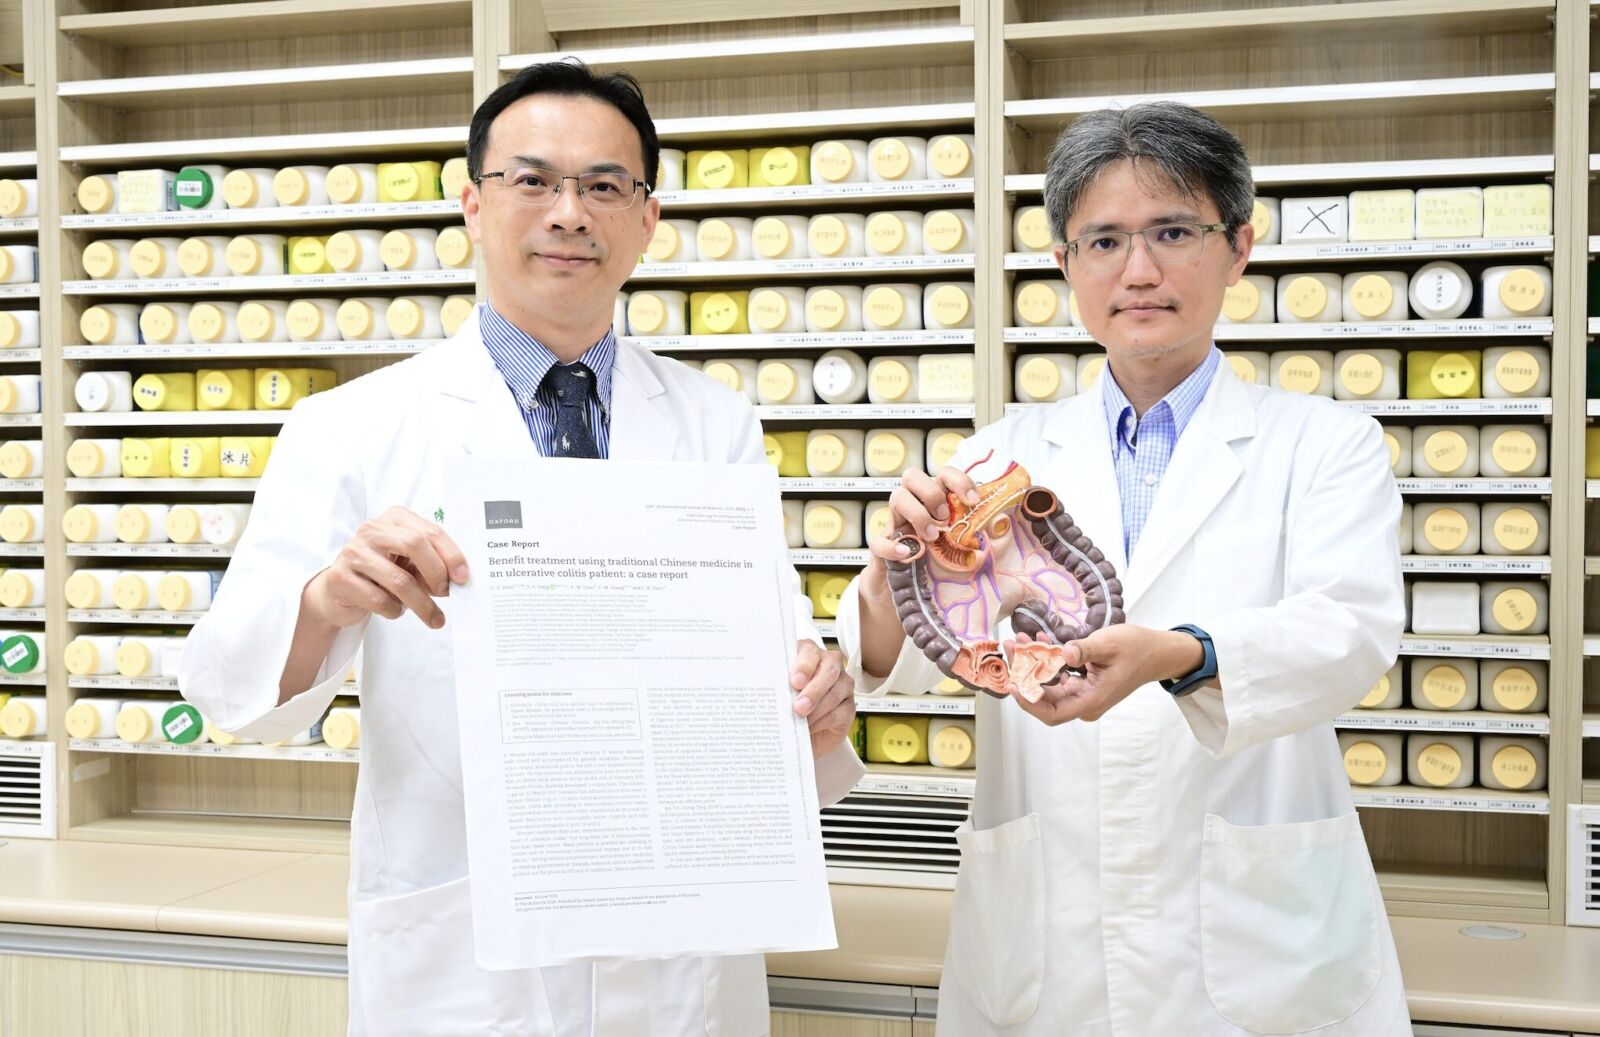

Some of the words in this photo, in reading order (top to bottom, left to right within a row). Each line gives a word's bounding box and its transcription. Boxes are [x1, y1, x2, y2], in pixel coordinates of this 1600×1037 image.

[222, 450, 249, 466] 冰片
[487, 541, 509, 549] Case
[511, 540, 540, 550] Report
[488, 556, 525, 566] Benefit
[527, 557, 577, 566] treatment
[578, 557, 606, 568] using
[607, 556, 658, 567] traditional
[659, 558, 698, 568] Chinese
[699, 560, 742, 569] medicine
[743, 560, 753, 569] in
[505, 568, 556, 578] ulcerative
[557, 569, 587, 578] colitis
[589, 569, 626, 580] patient:
[628, 571, 634, 579] a
[636, 571, 658, 579] case
[659, 571, 689, 581] report
